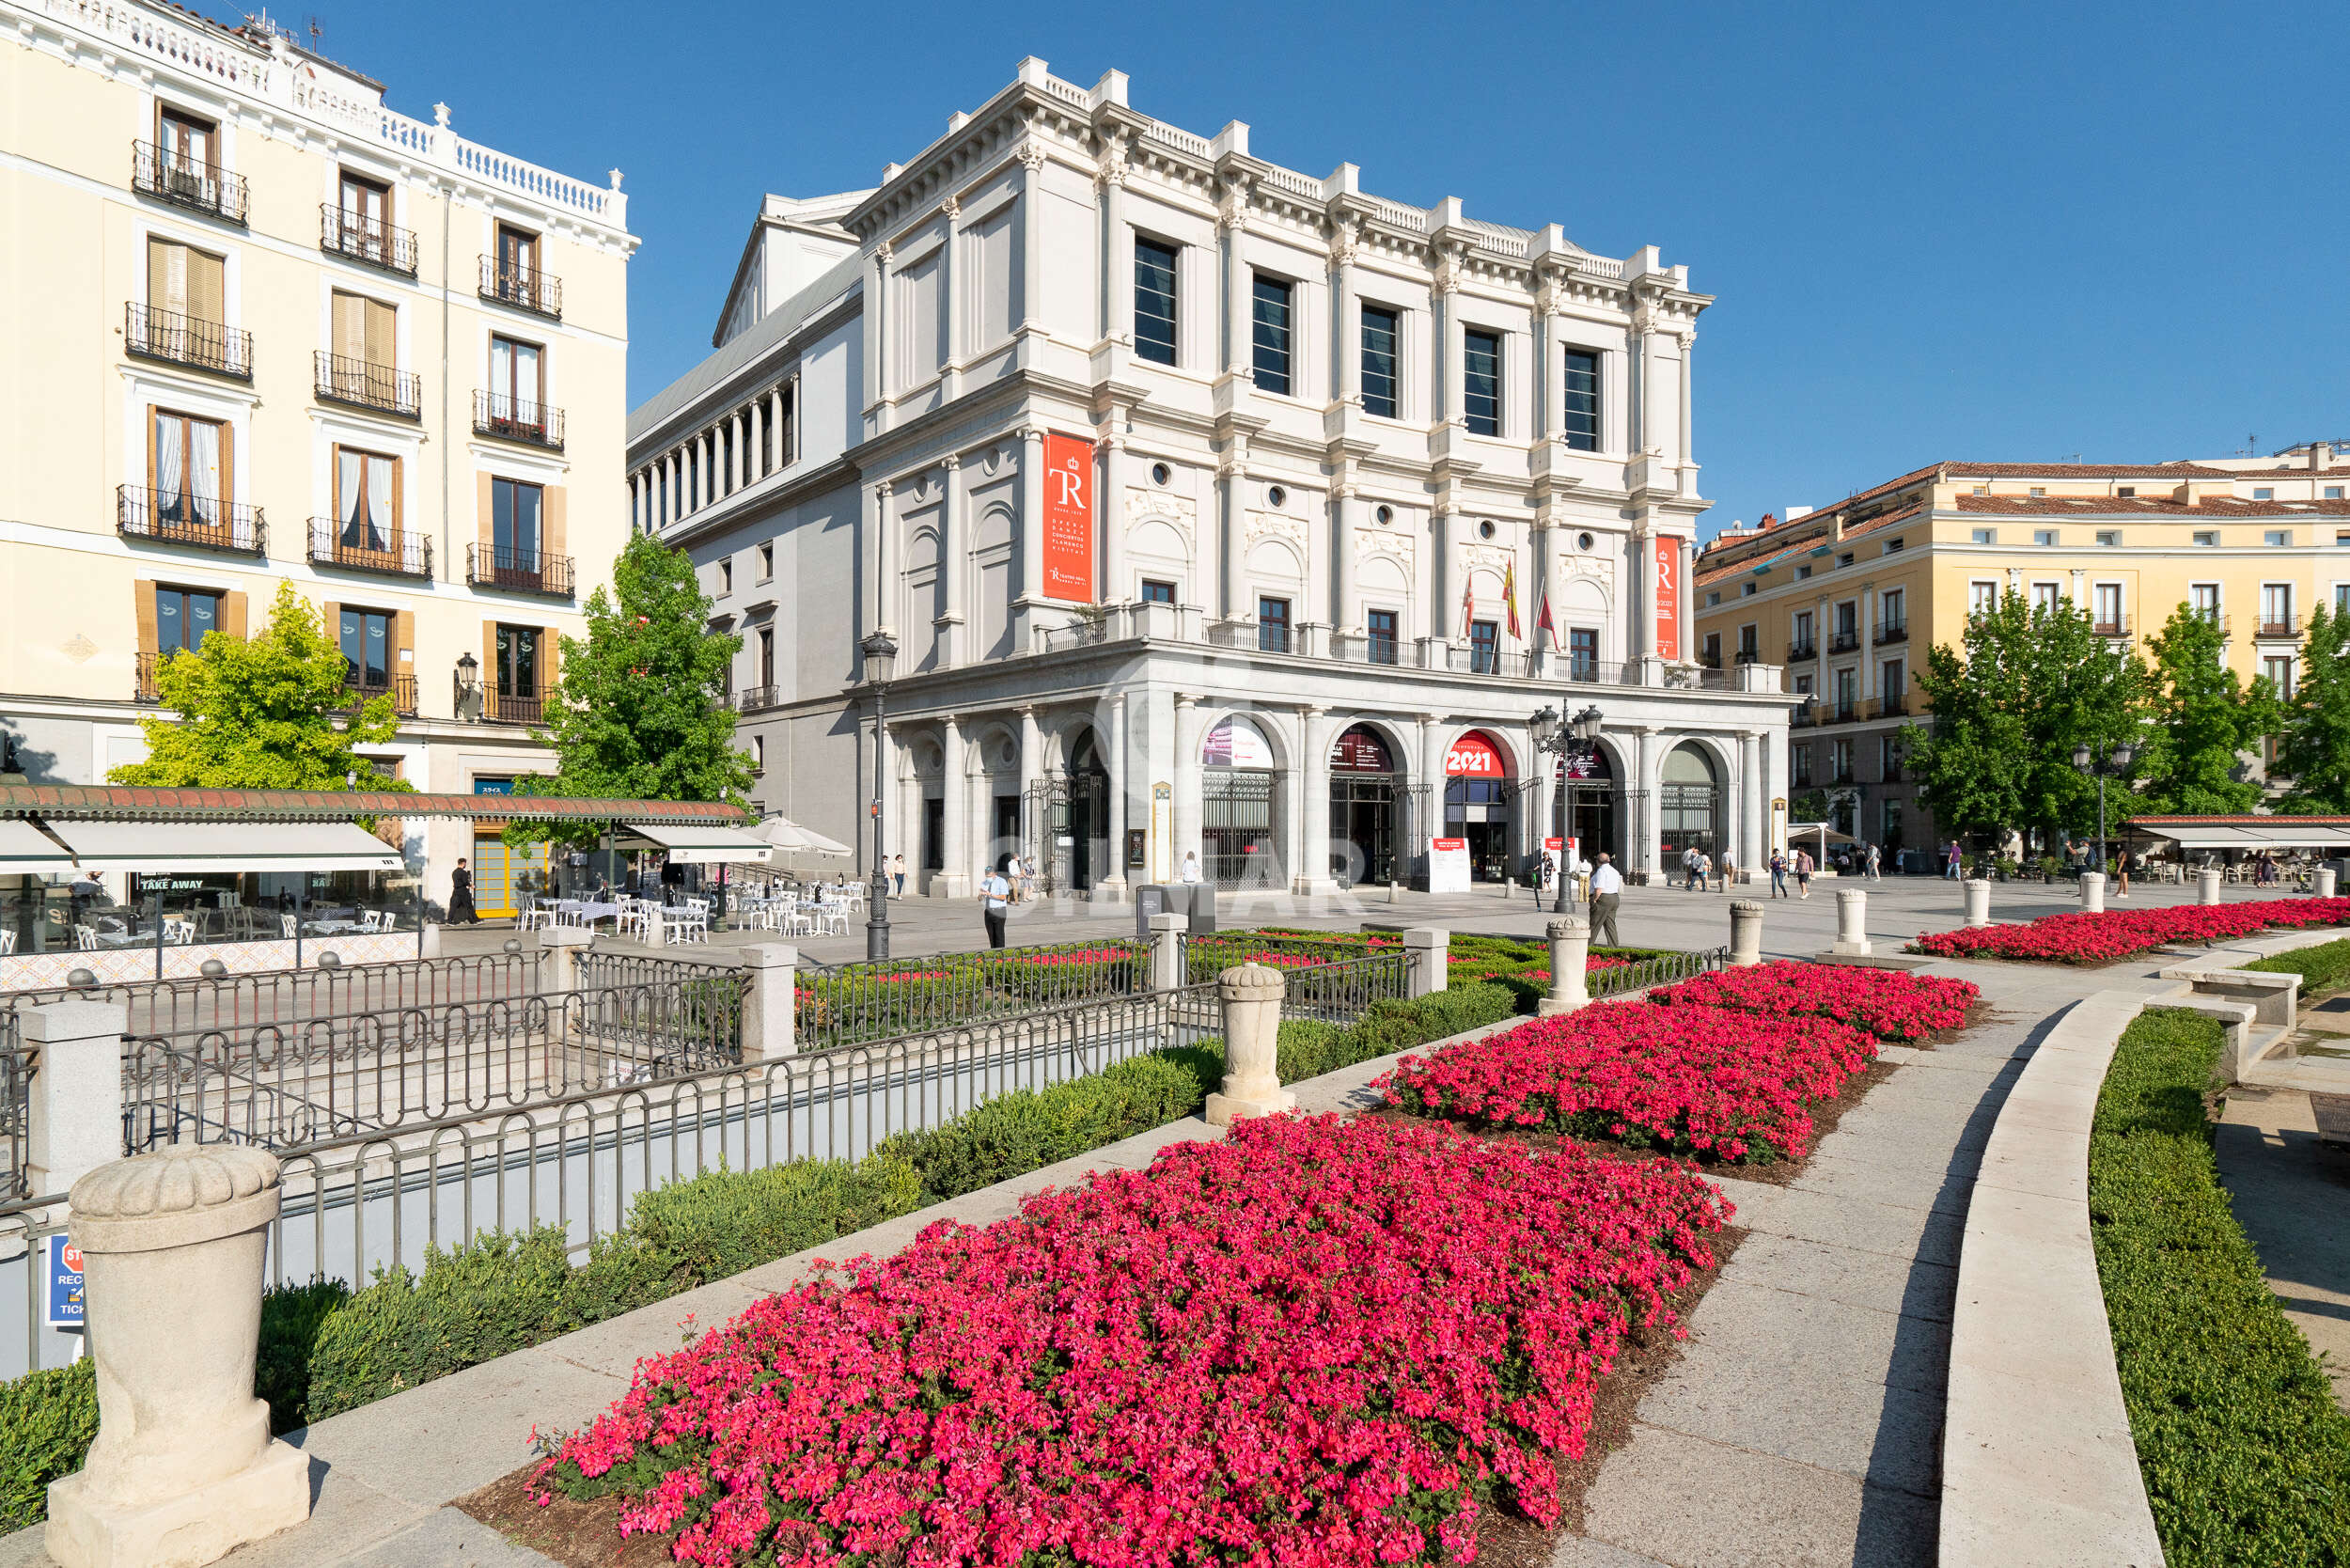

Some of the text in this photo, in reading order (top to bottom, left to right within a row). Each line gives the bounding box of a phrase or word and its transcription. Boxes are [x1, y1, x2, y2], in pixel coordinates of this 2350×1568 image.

[1049, 468, 1087, 509] TR
[1052, 539, 1084, 549] FLAMENCO
[1448, 750, 1491, 773] 2021
[143, 879, 169, 890] TAKE
[171, 880, 203, 889] AWAY
[67, 1248, 83, 1261] ST
[58, 1275, 83, 1285] REC
